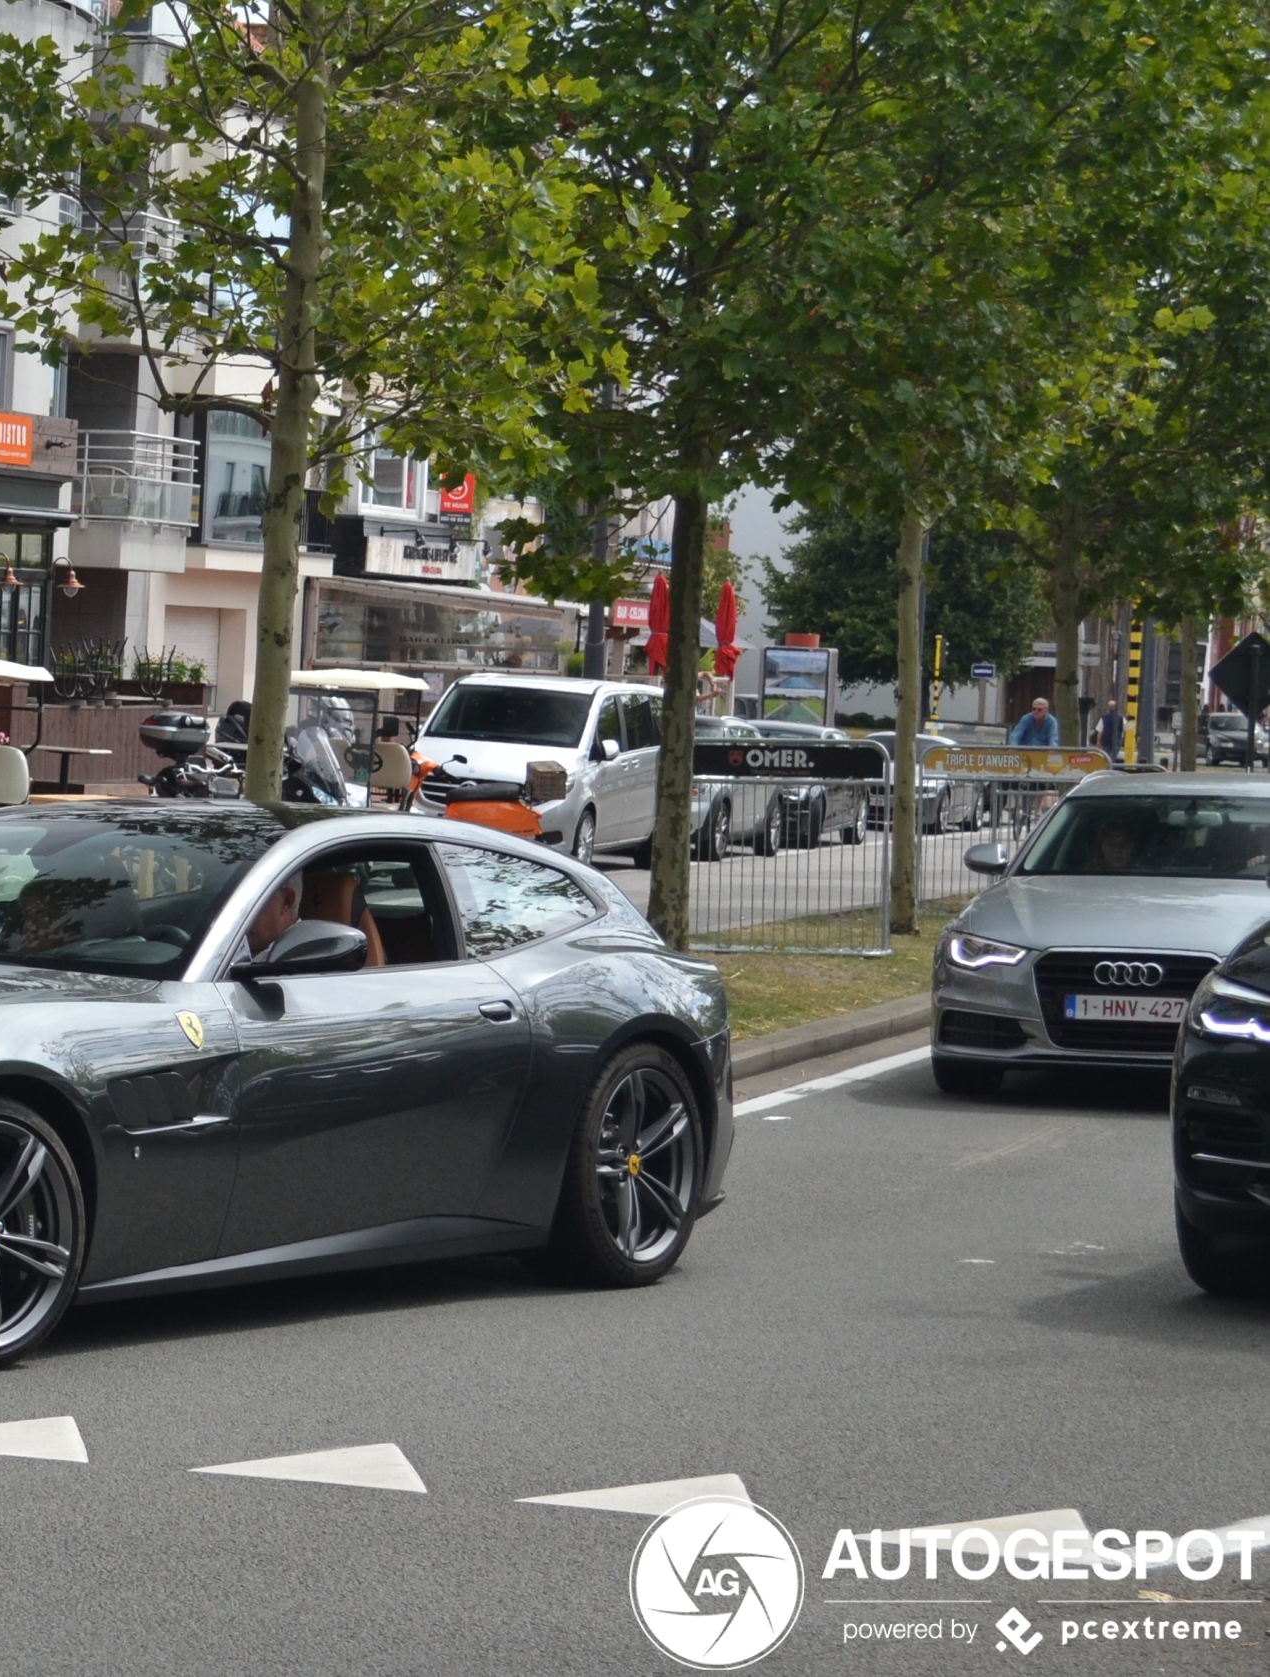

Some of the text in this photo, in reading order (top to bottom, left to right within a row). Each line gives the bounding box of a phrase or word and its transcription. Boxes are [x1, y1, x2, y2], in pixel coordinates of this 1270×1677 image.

[398, 635, 471, 645] BAR-CELONA
[945, 753, 1020, 767] TRIPLE D'ANVERS
[1066, 1008, 1074, 1018] B
